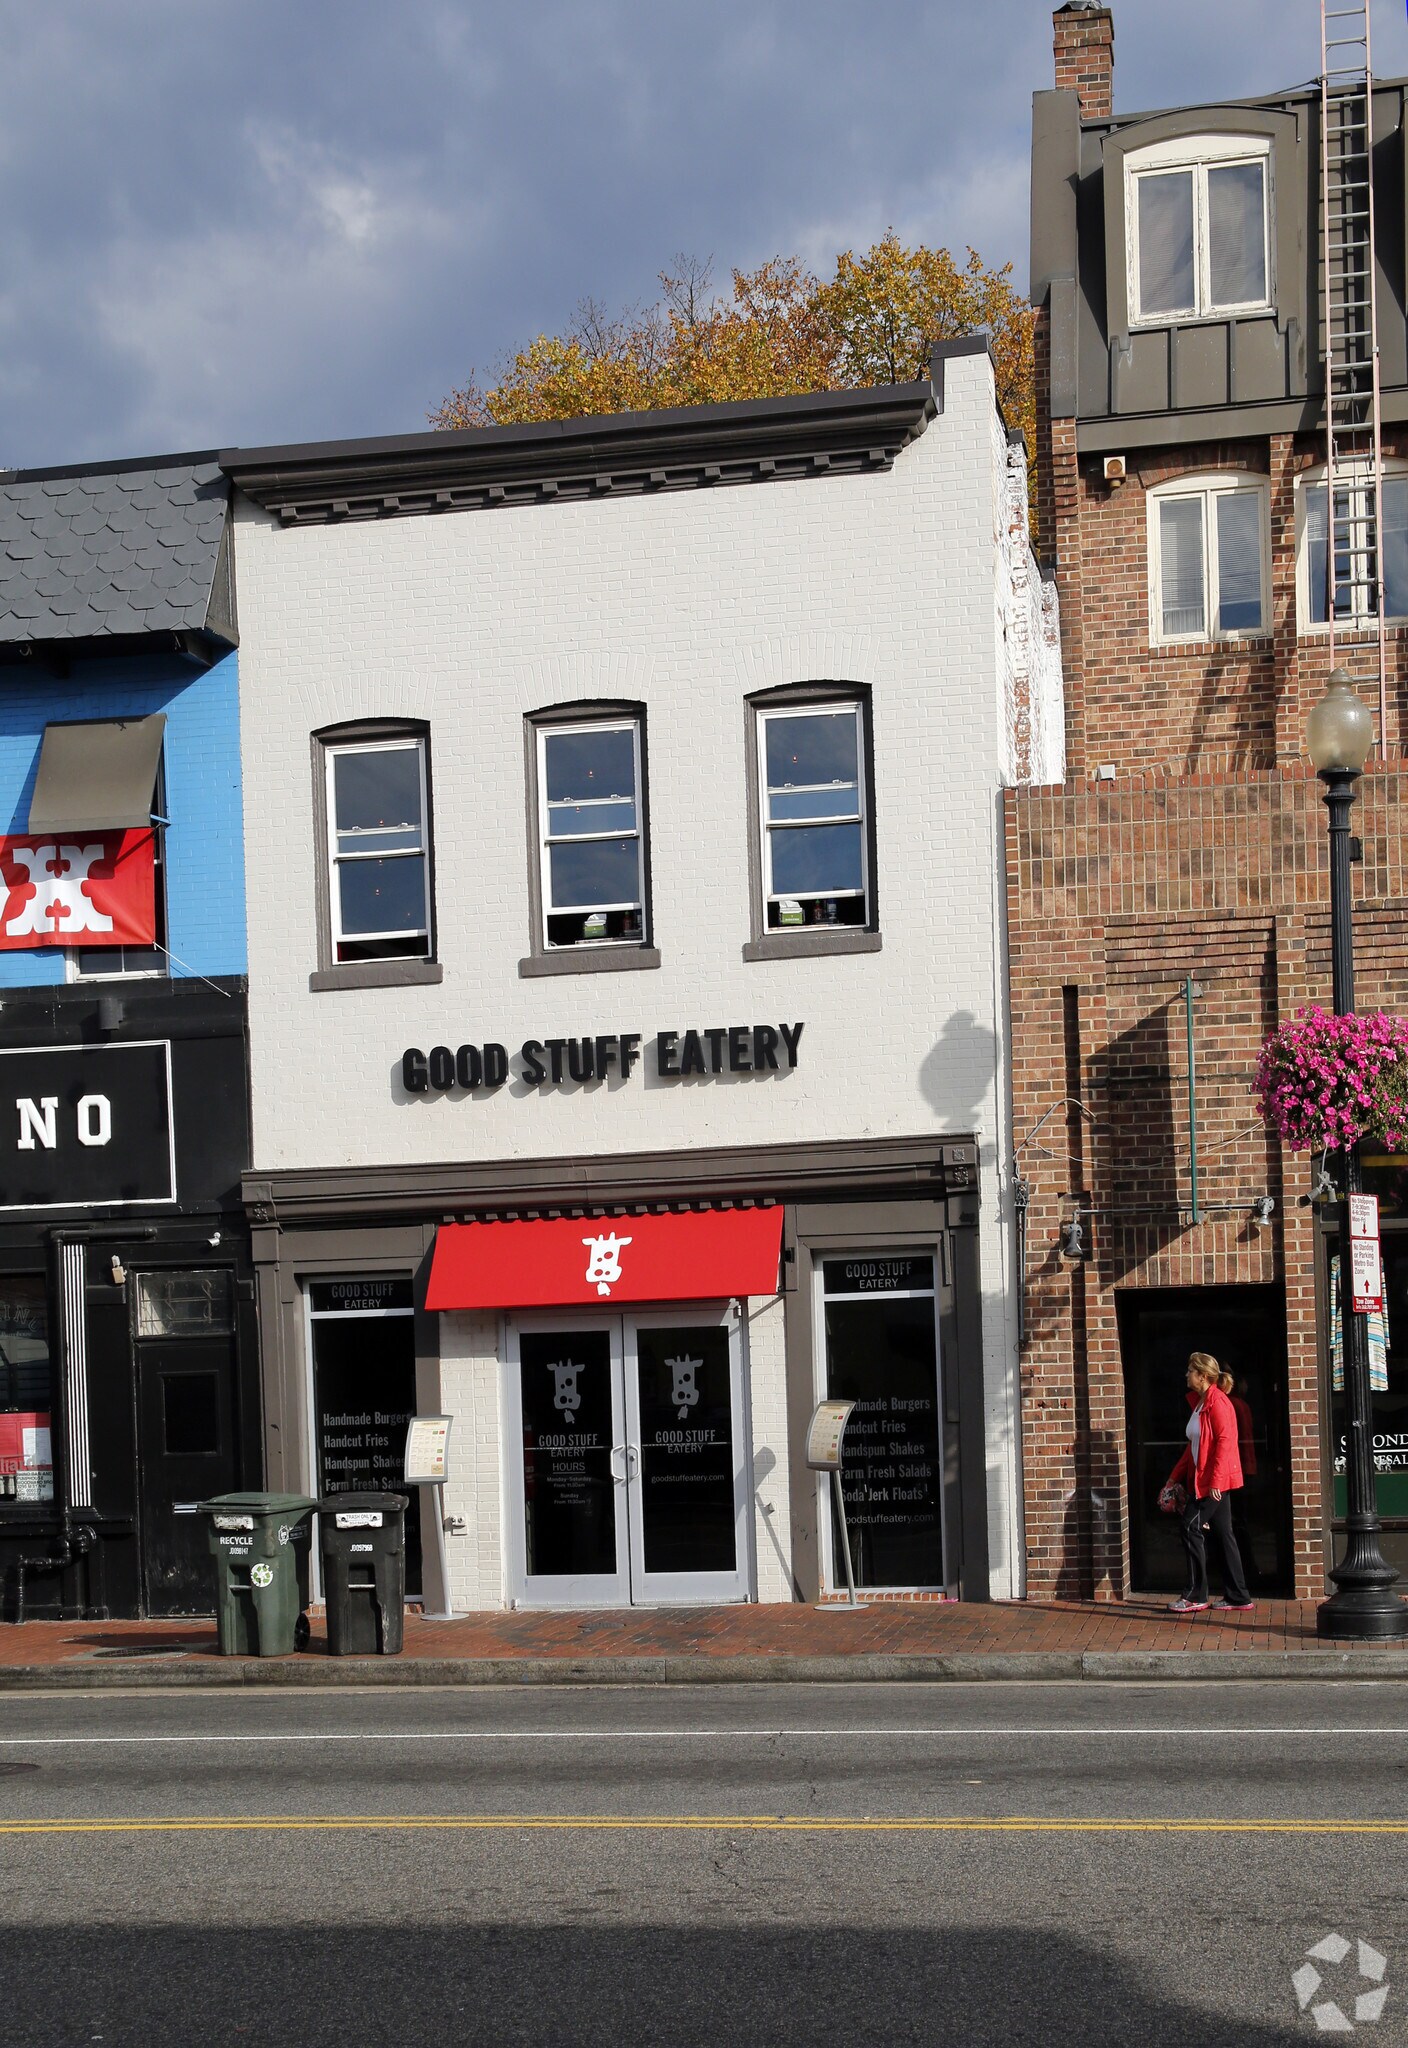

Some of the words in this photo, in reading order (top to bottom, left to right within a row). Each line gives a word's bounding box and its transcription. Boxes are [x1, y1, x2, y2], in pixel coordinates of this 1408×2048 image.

[0, 844, 114, 936] X
[402, 1043, 509, 1092] GOOD
[521, 1033, 641, 1086] STUFF
[657, 1022, 804, 1077] EATERY
[1359, 1244, 1374, 1252] Standing
[1359, 1252, 1374, 1260] Parking
[846, 1263, 876, 1277] GOOD
[879, 1262, 912, 1276] STUFF
[859, 1278, 898, 1288] EATERY
[332, 1284, 360, 1298] GOOD
[363, 1283, 394, 1296] STUFF
[344, 1299, 381, 1308] EATERY
[853, 1398, 887, 1411] dmade
[891, 1397, 930, 1412] Burgers
[323, 1412, 371, 1426] Handmade
[375, 1412, 411, 1426] Burgers
[843, 1421, 878, 1434] andcut
[881, 1420, 906, 1433] Fries
[324, 1434, 362, 1448] Handcut
[365, 1433, 389, 1447] Fries
[539, 1435, 566, 1447] GOOD
[568, 1433, 598, 1446] STUFF
[655, 1431, 683, 1443] GOOD
[685, 1430, 715, 1442] STUFF
[551, 1448, 586, 1457] EATERY
[668, 1445, 704, 1453] EATERY
[890, 1442, 925, 1455] Shakes
[324, 1456, 370, 1471] Handspun
[552, 1462, 585, 1471] HOURS
[868, 1465, 895, 1478] Fresh
[899, 1464, 931, 1478] Salads
[325, 1479, 349, 1491] Farm
[352, 1477, 378, 1490] Fresh
[651, 1474, 725, 1483] goodstuffeatery.com
[842, 1489, 864, 1502] Soda
[868, 1488, 889, 1501] Jerk
[893, 1487, 923, 1500] Floats
[845, 1514, 934, 1525] oodstuffeatery.com
[220, 1537, 253, 1545] RECYCLE
